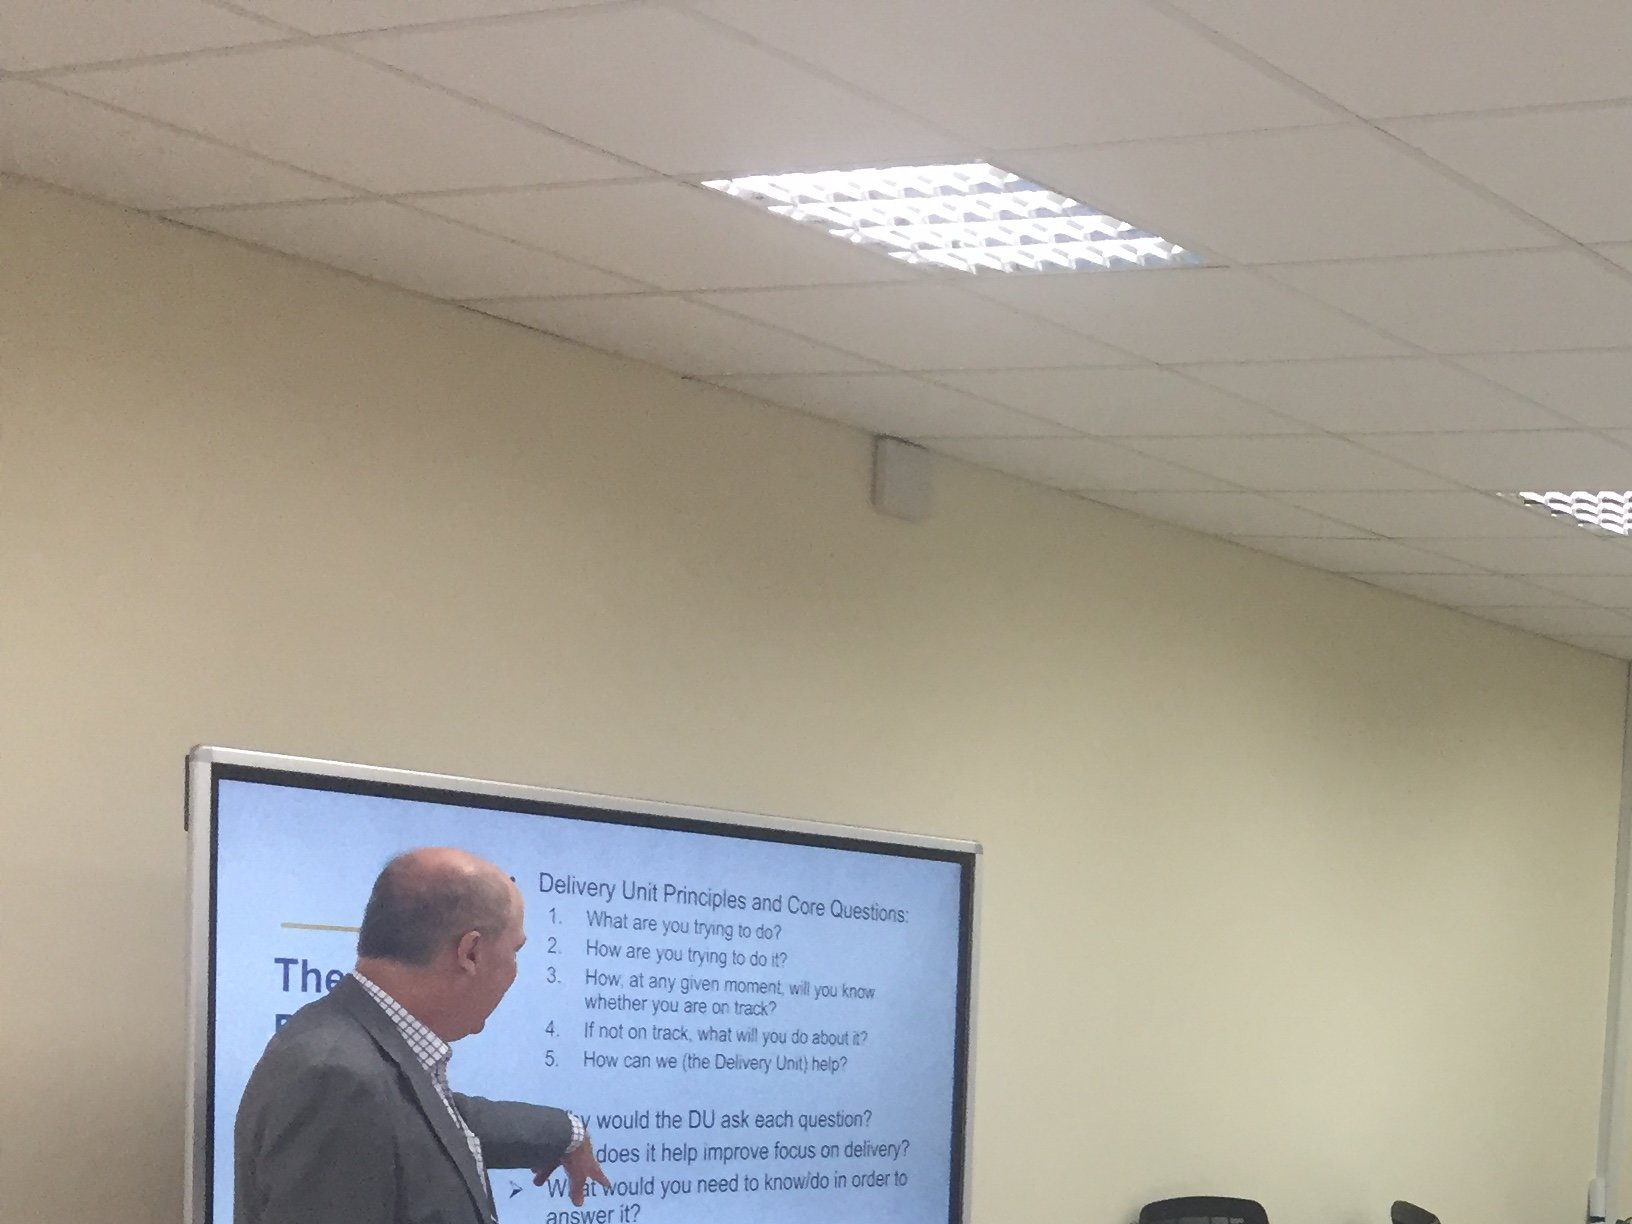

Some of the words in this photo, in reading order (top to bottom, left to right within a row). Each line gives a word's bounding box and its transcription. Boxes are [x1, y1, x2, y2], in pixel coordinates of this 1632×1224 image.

[539, 872, 616, 903] Delivery
[622, 879, 658, 902] Unit
[664, 884, 746, 911] Principles
[752, 895, 782, 912] and
[788, 895, 825, 916] Core
[831, 899, 909, 923] Questions:
[549, 908, 562, 924] 1.
[587, 910, 628, 929] What
[633, 917, 657, 931] are
[662, 920, 689, 936] you
[694, 919, 734, 941] trying
[738, 923, 751, 939] to
[756, 924, 782, 940] do?
[547, 937, 562, 954] 2.
[587, 939, 622, 957] How
[626, 945, 650, 959] are
[656, 948, 683, 964] you
[688, 947, 727, 968] trying
[732, 951, 746, 966] to
[750, 951, 767, 966] do
[772, 952, 788, 968] it?
[274, 957, 344, 993] The
[546, 966, 561, 984] 3.
[585, 968, 624, 989] How,
[629, 972, 644, 988] at
[649, 975, 676, 992] any
[681, 976, 719, 994] given
[724, 980, 785, 997] moment,
[789, 981, 810, 997] will
[814, 985, 838, 1001] you
[842, 983, 876, 999] know
[584, 994, 648, 1011] whether
[652, 999, 678, 1016] you
[683, 1001, 707, 1014] are
[712, 1001, 729, 1015] on
[735, 1001, 777, 1016] track?
[545, 1020, 560, 1037] 4.
[584, 1021, 595, 1038] If
[599, 1024, 624, 1039] not
[628, 1026, 647, 1039] on
[653, 1024, 692, 1043] track,
[697, 1026, 732, 1043] what
[737, 1027, 758, 1043] will
[762, 1032, 787, 1047] you
[791, 1029, 808, 1045] do
[812, 1030, 849, 1046] about
[853, 1030, 868, 1046] it?
[545, 1050, 559, 1067] 5.
[584, 1051, 618, 1068] How
[624, 1054, 650, 1068] can
[656, 1055, 677, 1069] we
[683, 1052, 710, 1073] (the
[715, 1053, 772, 1074] Delivery
[776, 1055, 808, 1074] Unit)
[812, 1056, 848, 1075] help?
[597, 1110, 649, 1129] would
[655, 1110, 682, 1129] the
[689, 1110, 715, 1128] DU
[721, 1110, 750, 1129] ask
[755, 1110, 794, 1128] each
[798, 1109, 873, 1132] question?
[596, 1144, 640, 1163] does
[646, 1142, 656, 1163] it
[661, 1143, 698, 1165] help
[703, 1143, 769, 1165] improve
[774, 1141, 816, 1160] focus
[820, 1145, 840, 1158] on
[844, 1139, 910, 1161] delivery?
[547, 1178, 596, 1198] Wat
[660, 1179, 691, 1199] you
[697, 1174, 739, 1193] need
[744, 1176, 759, 1192] to
[764, 1171, 830, 1190] know/do
[834, 1170, 847, 1189] in
[851, 1170, 891, 1188] order
[894, 1170, 908, 1187] to
[620, 1203, 641, 1223] it?
